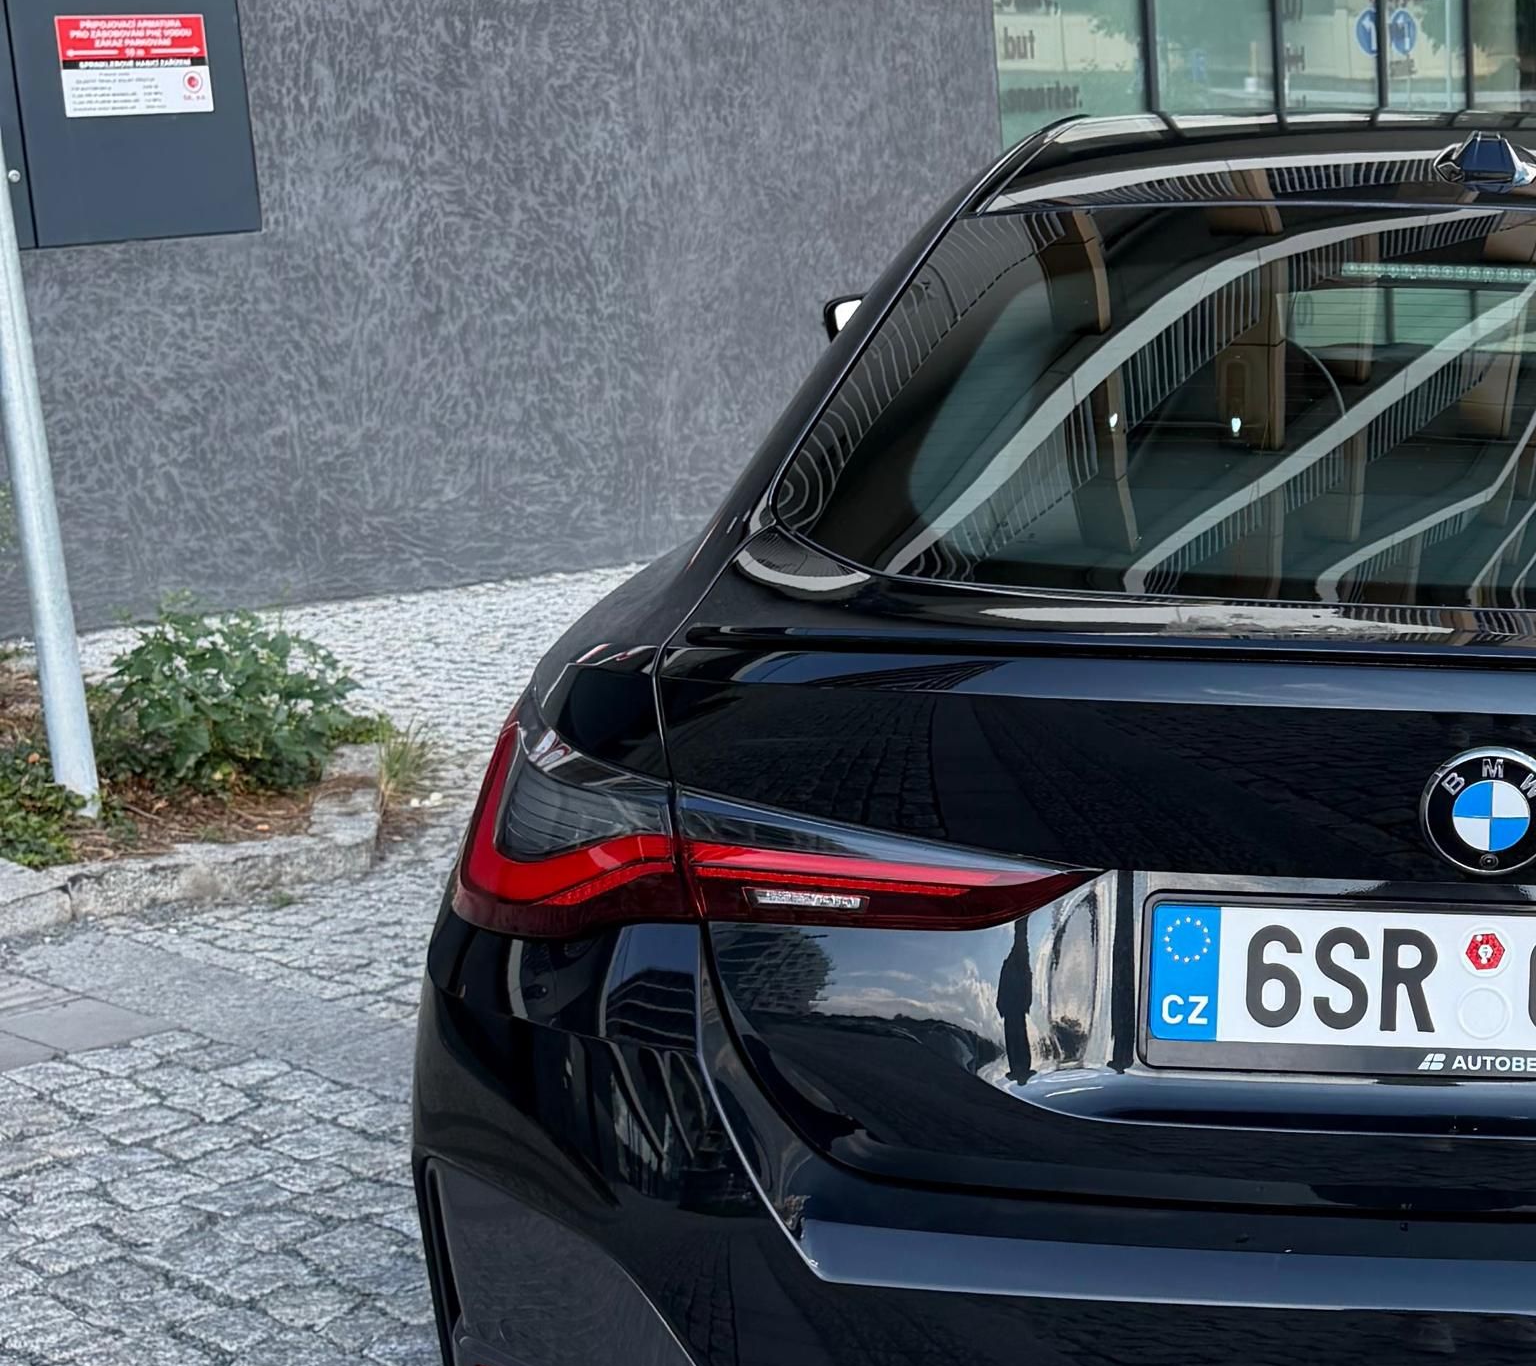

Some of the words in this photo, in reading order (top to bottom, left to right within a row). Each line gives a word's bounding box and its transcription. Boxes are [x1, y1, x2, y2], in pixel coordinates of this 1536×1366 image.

[1003, 26, 1035, 60] but
[1244, 924, 1439, 1034] 6SR
[1160, 995, 1209, 1026] CZ
